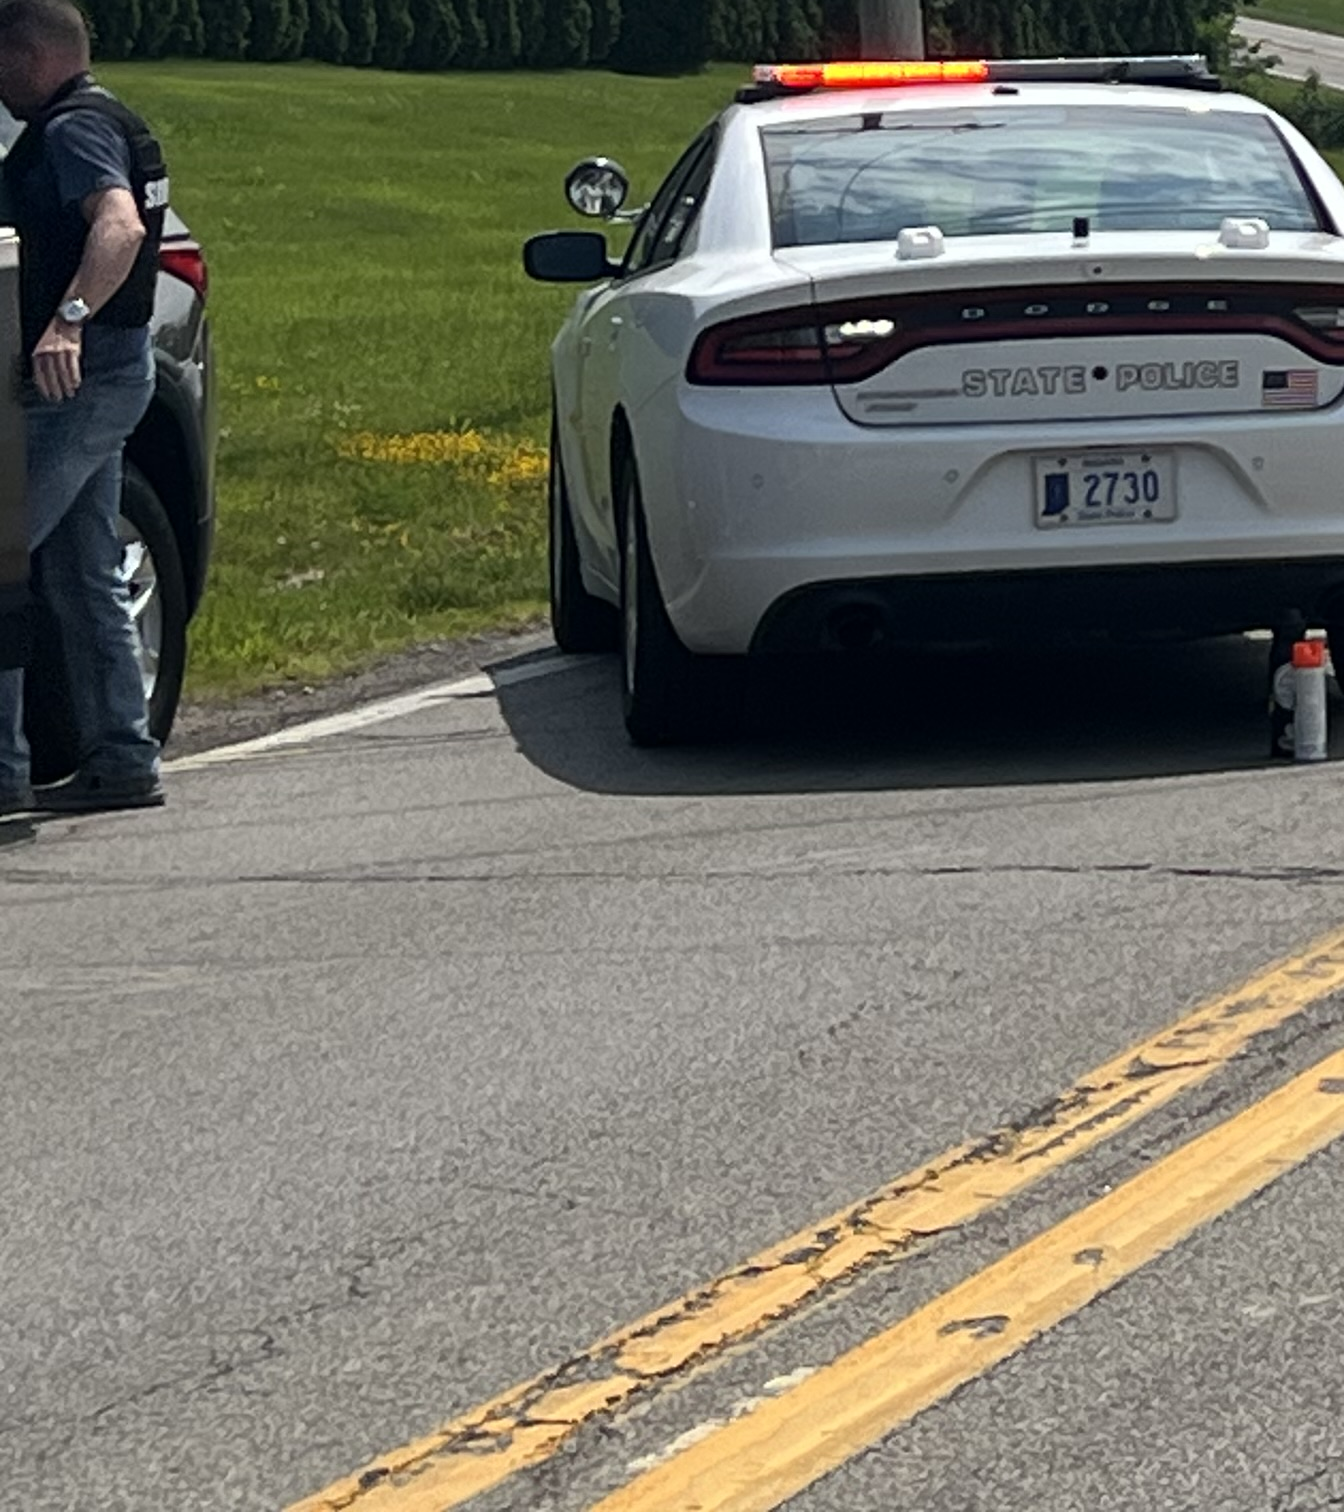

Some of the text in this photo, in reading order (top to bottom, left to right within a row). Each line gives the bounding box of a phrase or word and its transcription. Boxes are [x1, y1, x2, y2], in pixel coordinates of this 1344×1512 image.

[961, 365, 1088, 398] STATE
[1115, 359, 1240, 392] POLICE
[1083, 469, 1160, 508] 2730
